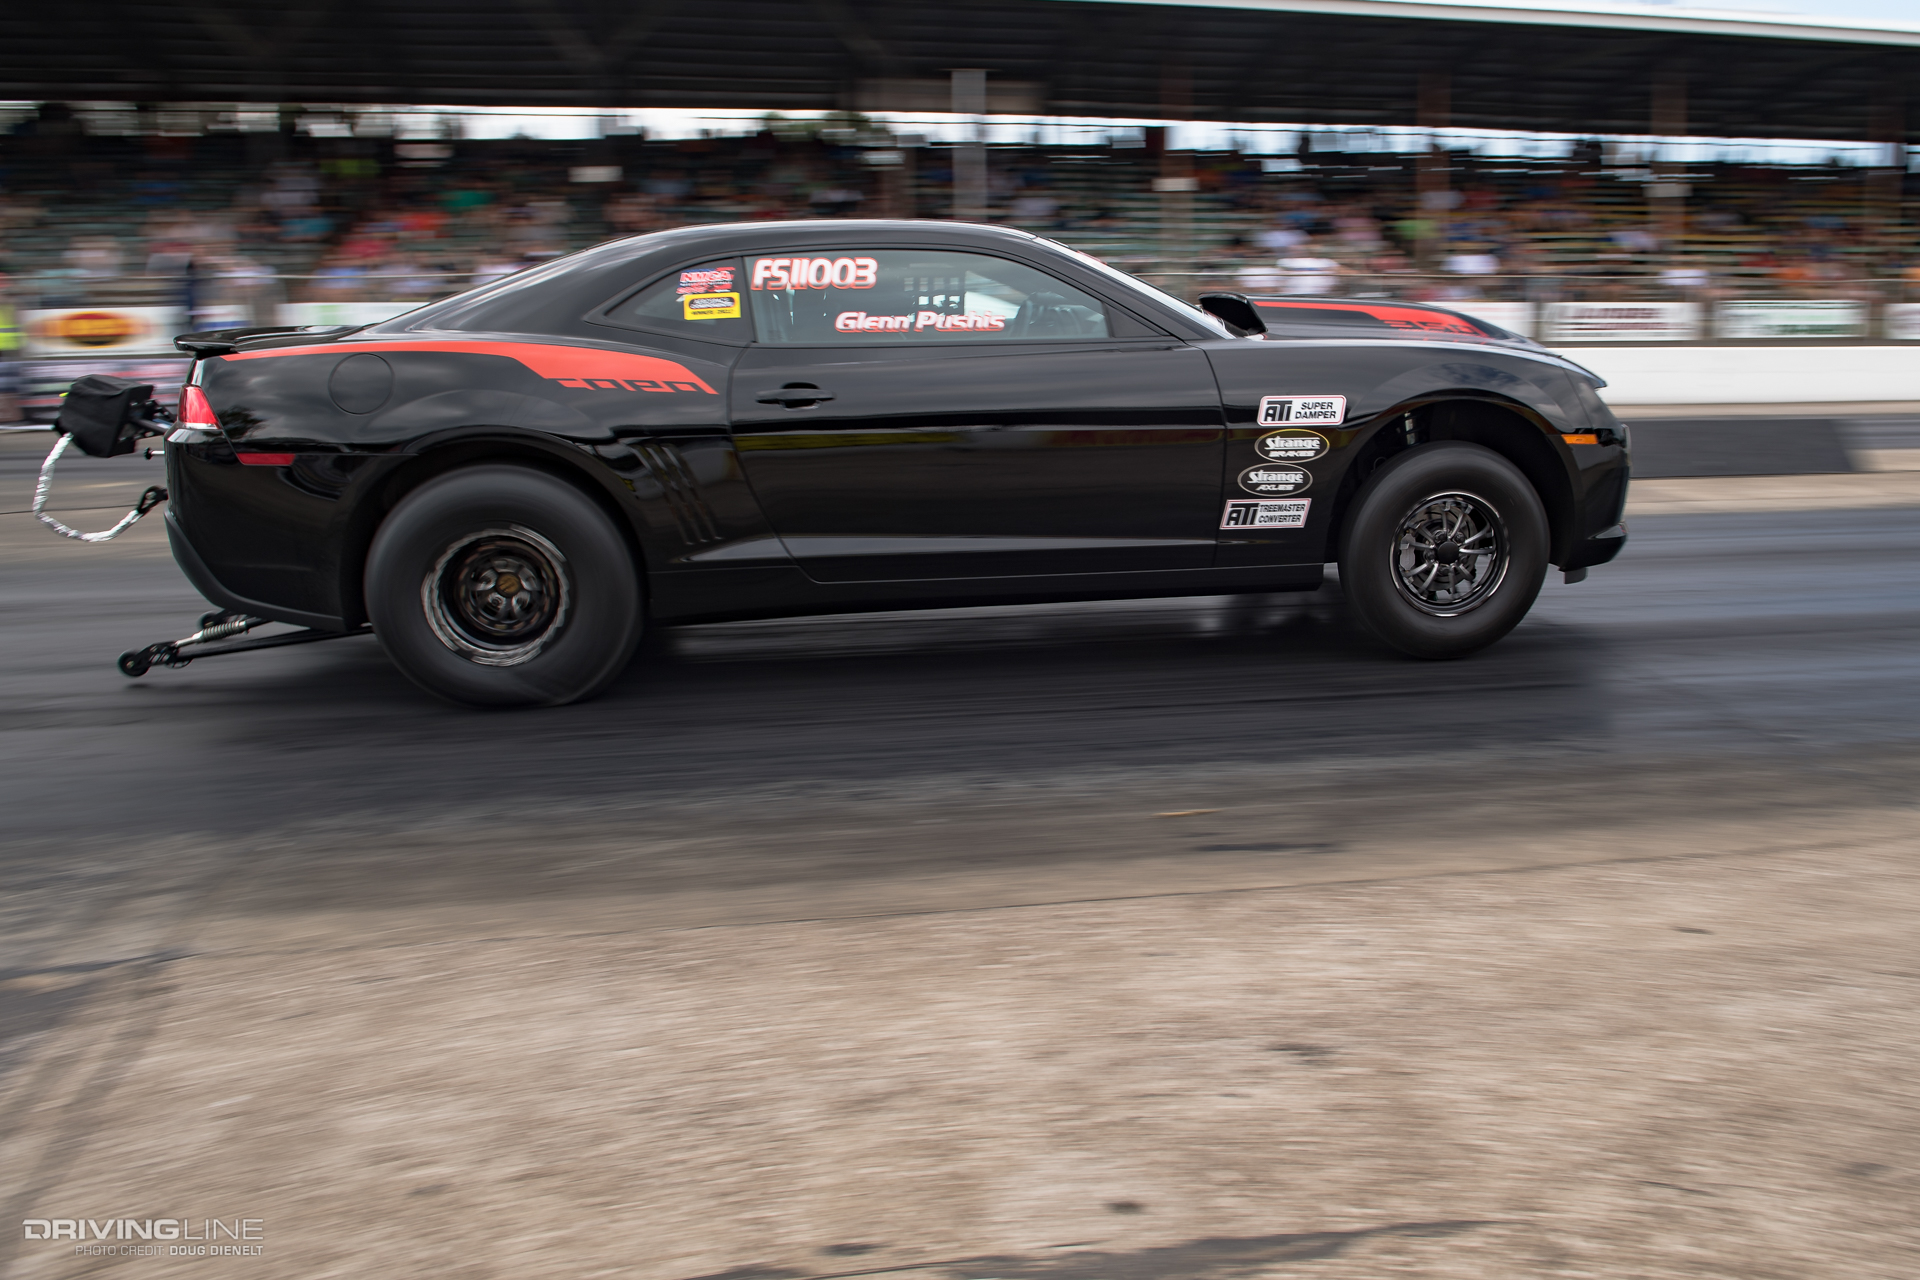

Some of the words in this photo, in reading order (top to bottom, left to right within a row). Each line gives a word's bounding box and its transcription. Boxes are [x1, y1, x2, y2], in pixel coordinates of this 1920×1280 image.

[834, 311, 911, 333] Glenn
[913, 310, 1006, 332] Pushis
[1264, 400, 1293, 422] ATI
[1301, 402, 1334, 410] SUPER
[1295, 410, 1337, 419] DAMPER
[1264, 436, 1321, 450] Strange
[1247, 470, 1304, 484] Strange
[1226, 503, 1260, 526] ATI
[1259, 504, 1306, 512] TREEMASTER
[1258, 514, 1302, 523] CONVERTER
